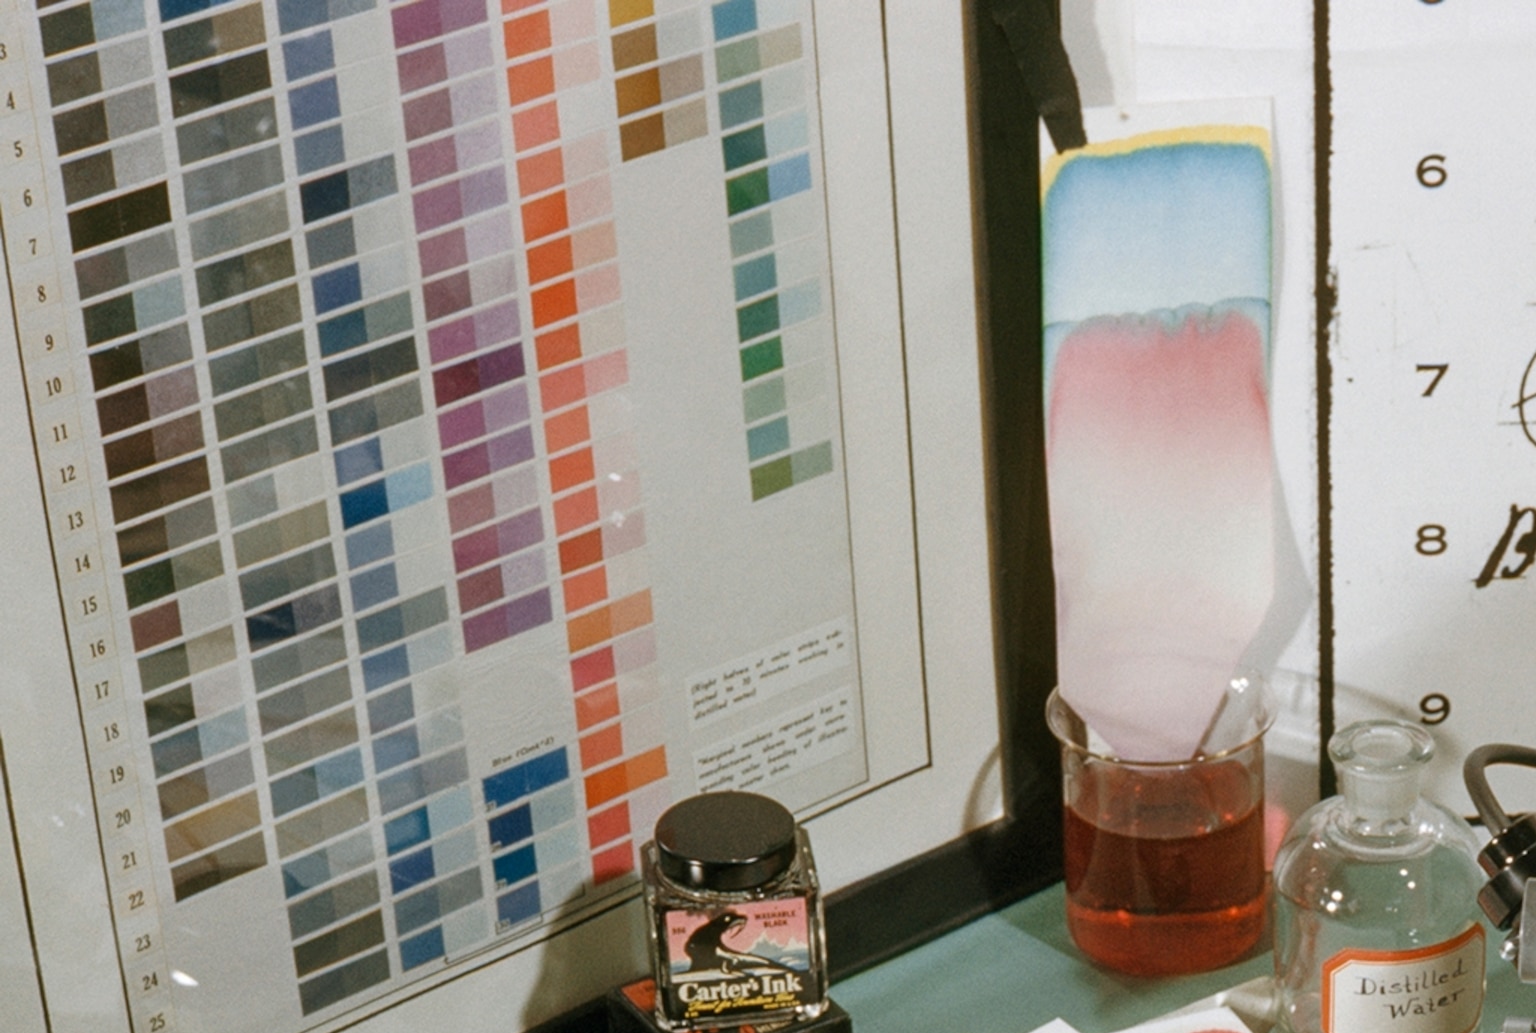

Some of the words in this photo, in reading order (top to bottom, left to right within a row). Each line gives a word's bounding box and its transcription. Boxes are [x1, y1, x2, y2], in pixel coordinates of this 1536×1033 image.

[6, 92, 15, 109] 4
[14, 140, 23, 158] 5
[1416, 154, 1449, 188] 6
[23, 189, 32, 207] 6
[29, 238, 37, 255] 7
[37, 285, 46, 302] 8
[45, 334, 54, 351] 9
[45, 376, 62, 396] 10
[1416, 364, 1449, 397] 7
[53, 423, 68, 442] 11
[60, 464, 76, 484] 12
[68, 511, 84, 530] 13
[1414, 525, 1448, 556] 8
[75, 553, 90, 573] 14
[82, 595, 98, 615] 15
[90, 639, 105, 658] 16
[94, 680, 110, 700] 17
[1419, 692, 1452, 726] 9
[103, 723, 120, 742] 18
[109, 765, 125, 785] 19
[115, 808, 131, 828] 20
[121, 851, 137, 870] 21
[128, 890, 145, 910] 22
[764, 919, 787, 928] BLACK
[135, 934, 151, 952] 23
[142, 972, 159, 991] 24
[1354, 958, 1468, 996] Distilled
[678, 977, 760, 1003] Carter's
[761, 972, 803, 995] Ink
[1383, 988, 1465, 1019] Water
[149, 1013, 166, 1033] 25
